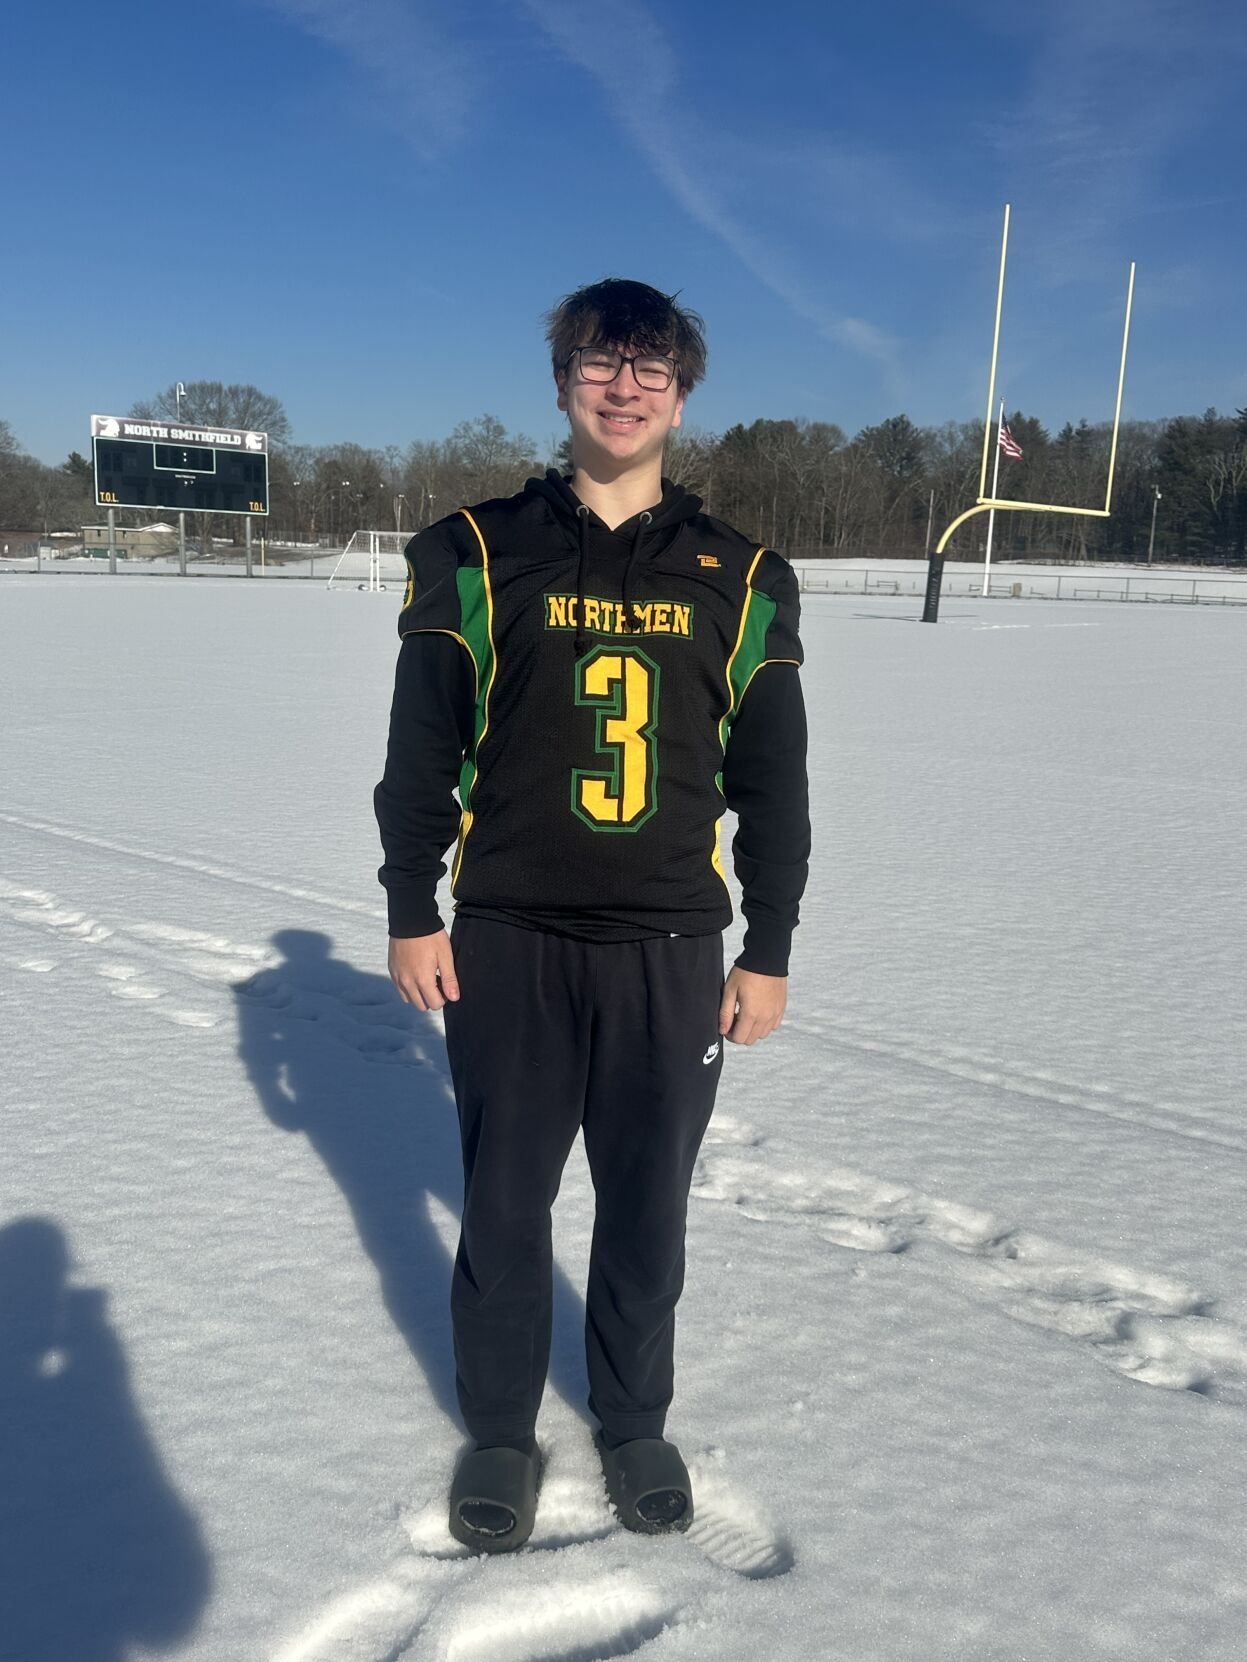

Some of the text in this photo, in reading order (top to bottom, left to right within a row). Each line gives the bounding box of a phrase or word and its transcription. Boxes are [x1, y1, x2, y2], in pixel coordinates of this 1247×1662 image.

[124, 424, 242, 445] NORTH SMITHFIELD
[572, 645, 660, 832] 3
